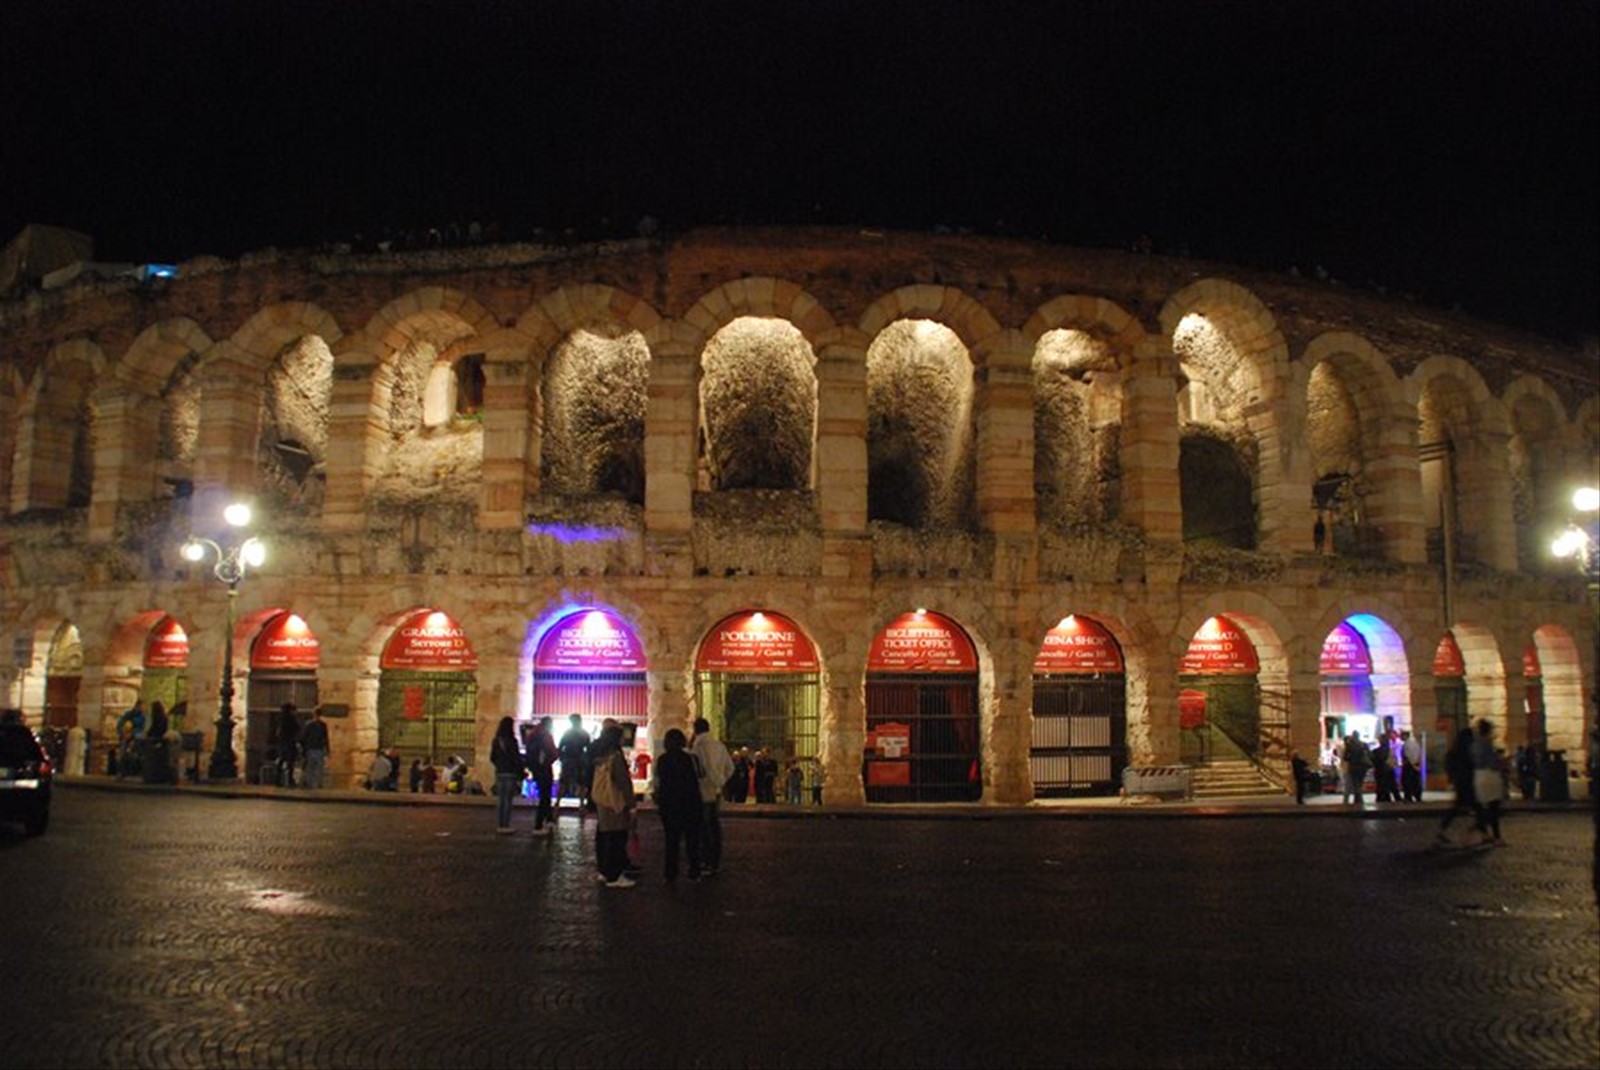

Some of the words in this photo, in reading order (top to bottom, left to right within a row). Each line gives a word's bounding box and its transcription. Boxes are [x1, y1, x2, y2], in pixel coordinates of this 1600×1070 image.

[720, 631, 796, 642] POLTRONE
[883, 639, 918, 648] TICKET
[919, 639, 953, 648] OFFICE
